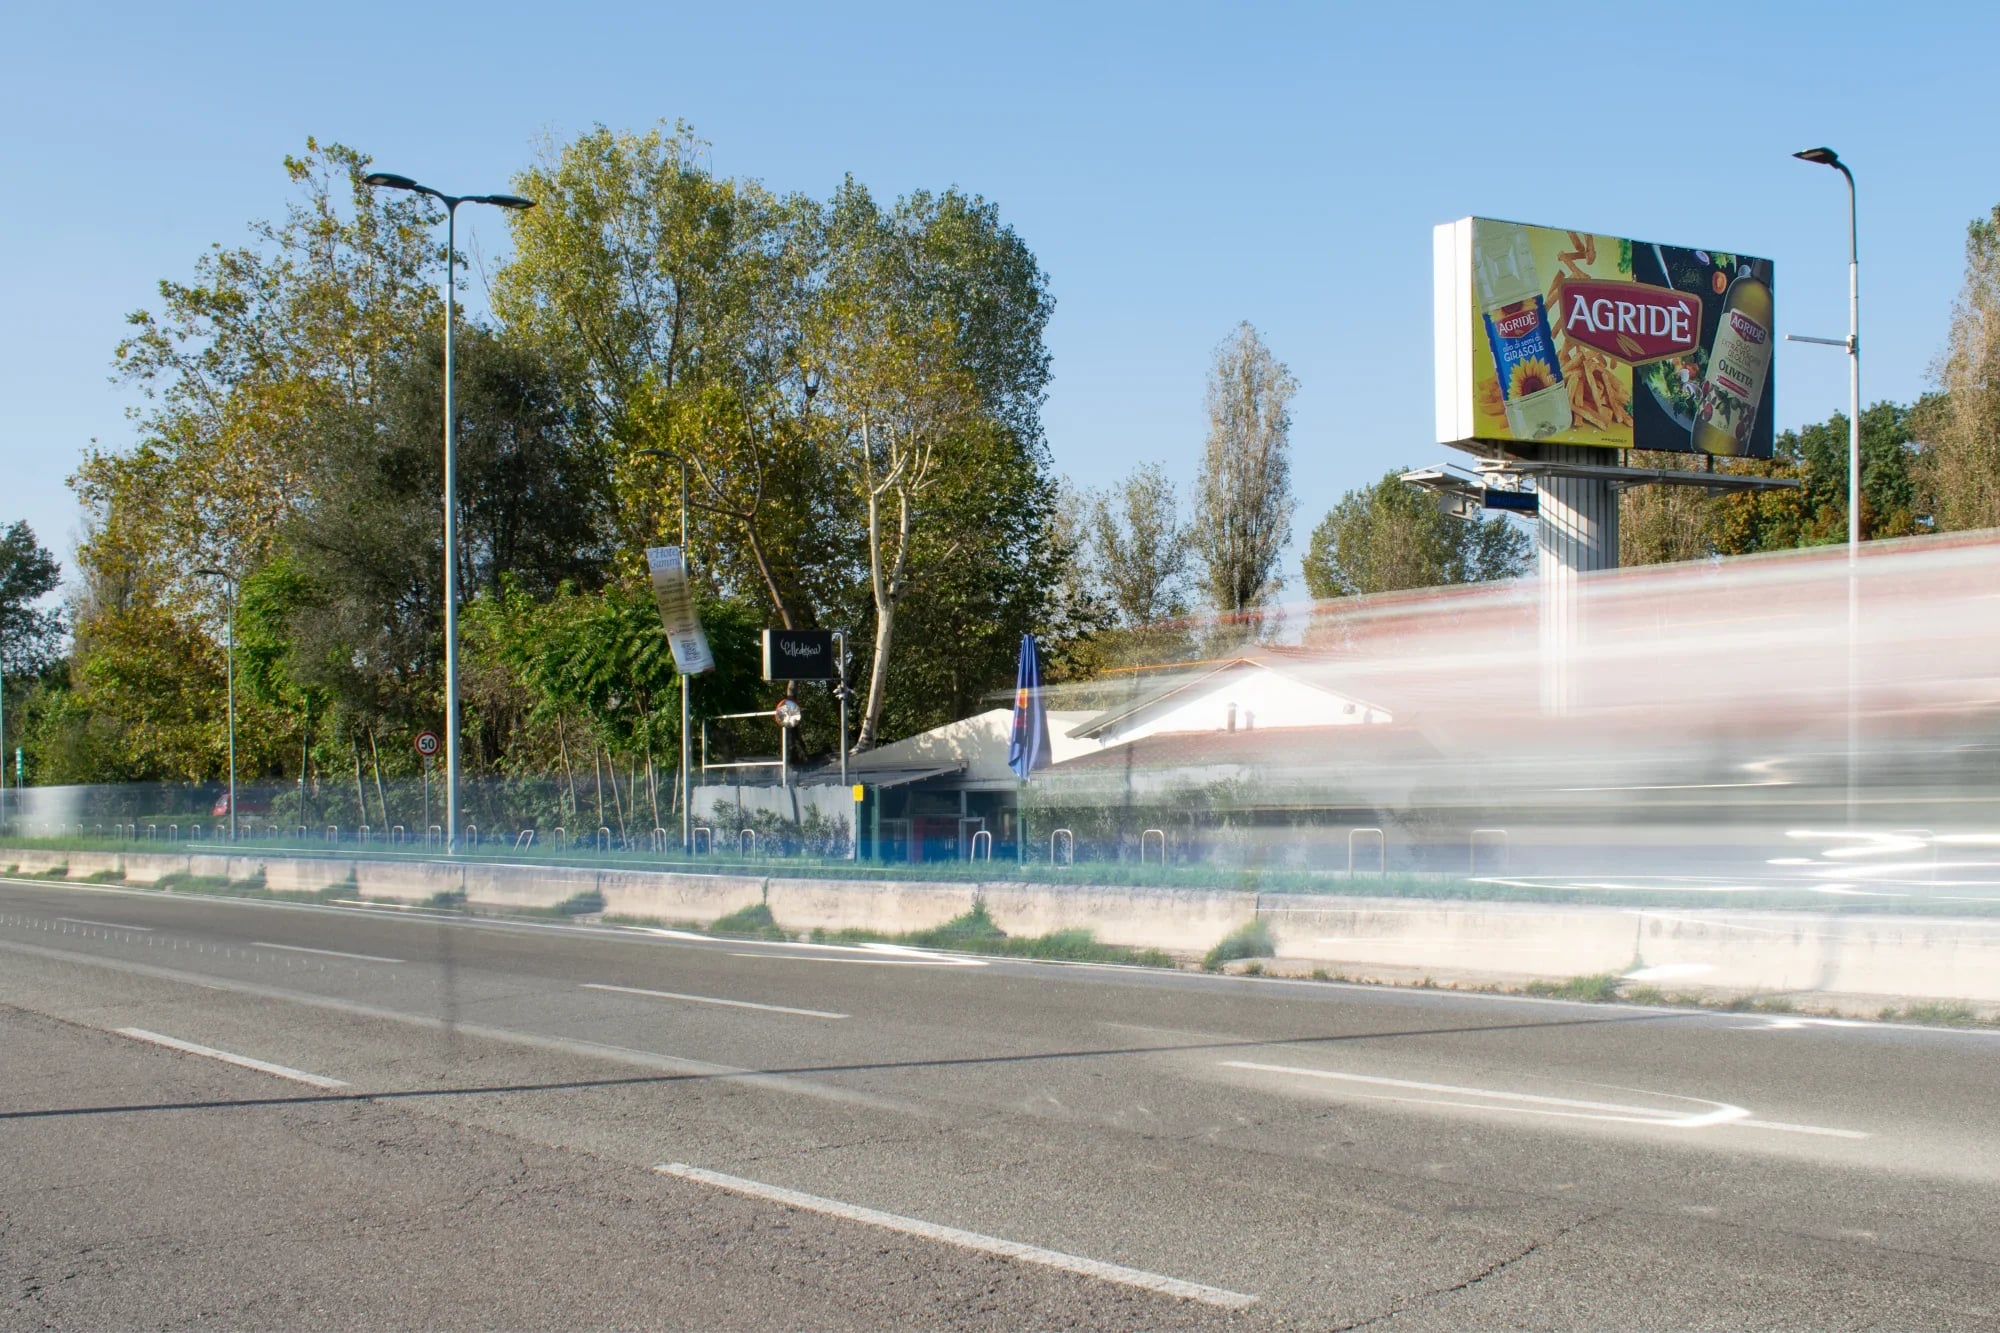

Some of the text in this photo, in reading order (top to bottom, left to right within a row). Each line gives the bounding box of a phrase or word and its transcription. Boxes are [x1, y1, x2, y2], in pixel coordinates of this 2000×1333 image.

[1499, 312, 1537, 335] AGRIDÈ
[1567, 294, 1692, 343] AGRIDÈ
[1504, 342, 1544, 362] GIRASOLE
[1719, 359, 1754, 388] OLIVETTA
[421, 738, 435, 750] 50
